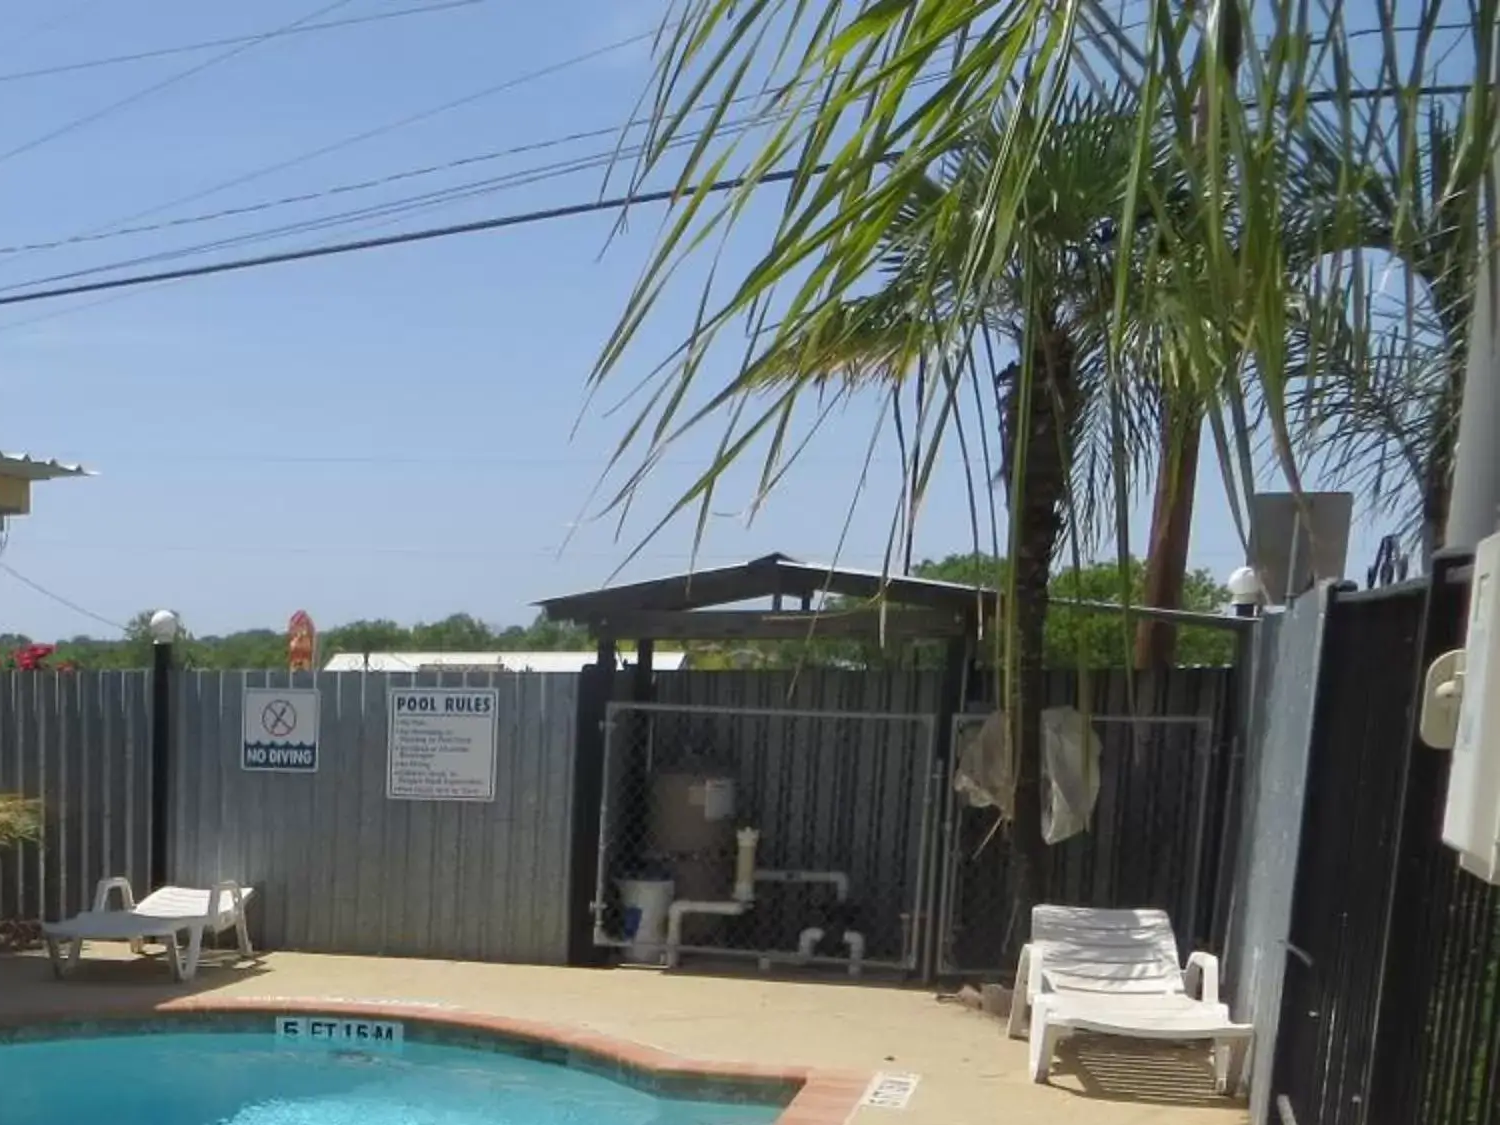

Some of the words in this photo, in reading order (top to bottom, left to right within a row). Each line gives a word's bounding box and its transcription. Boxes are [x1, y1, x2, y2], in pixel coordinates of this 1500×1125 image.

[396, 696, 437, 712] POOL
[445, 697, 491, 713] RULES
[246, 749, 266, 764] NO
[268, 749, 313, 766] DIVING
